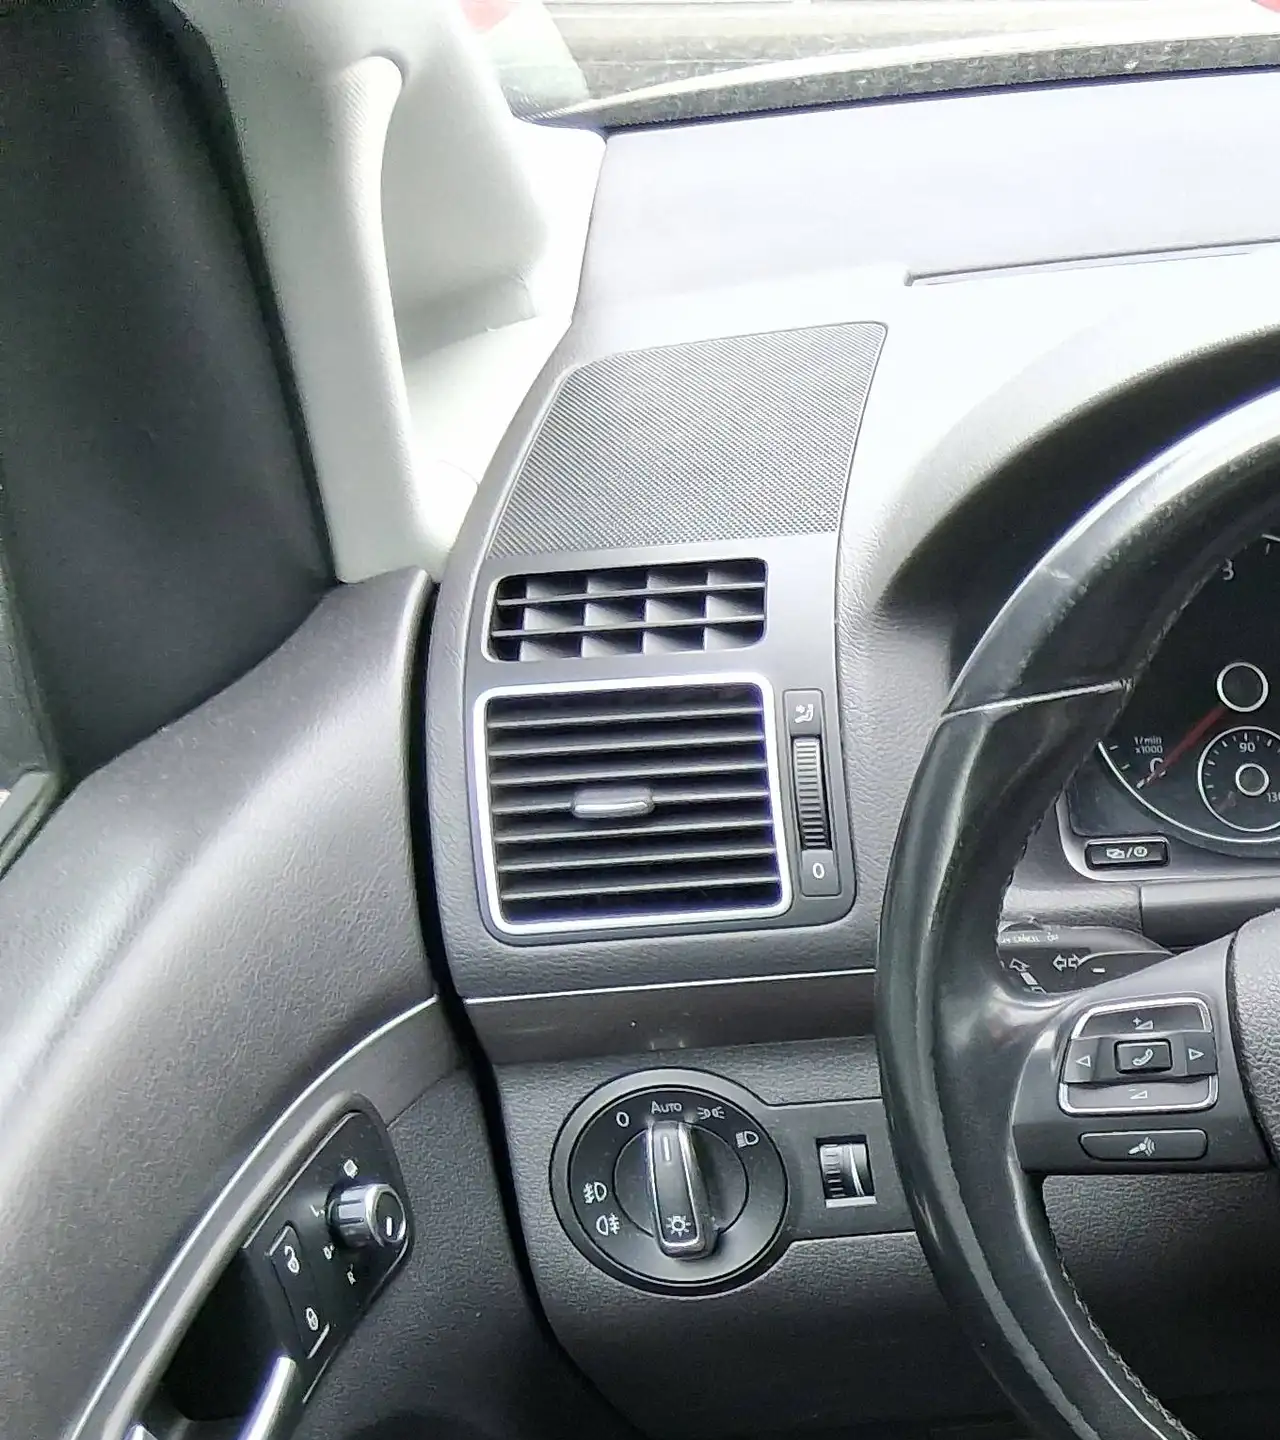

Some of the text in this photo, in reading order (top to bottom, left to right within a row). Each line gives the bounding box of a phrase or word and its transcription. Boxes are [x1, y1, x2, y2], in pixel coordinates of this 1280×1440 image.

[1221, 558, 1235, 581] 3
[1239, 742, 1255, 753] 90
[812, 862, 825, 880] 0
[616, 1111, 631, 1128] 0
